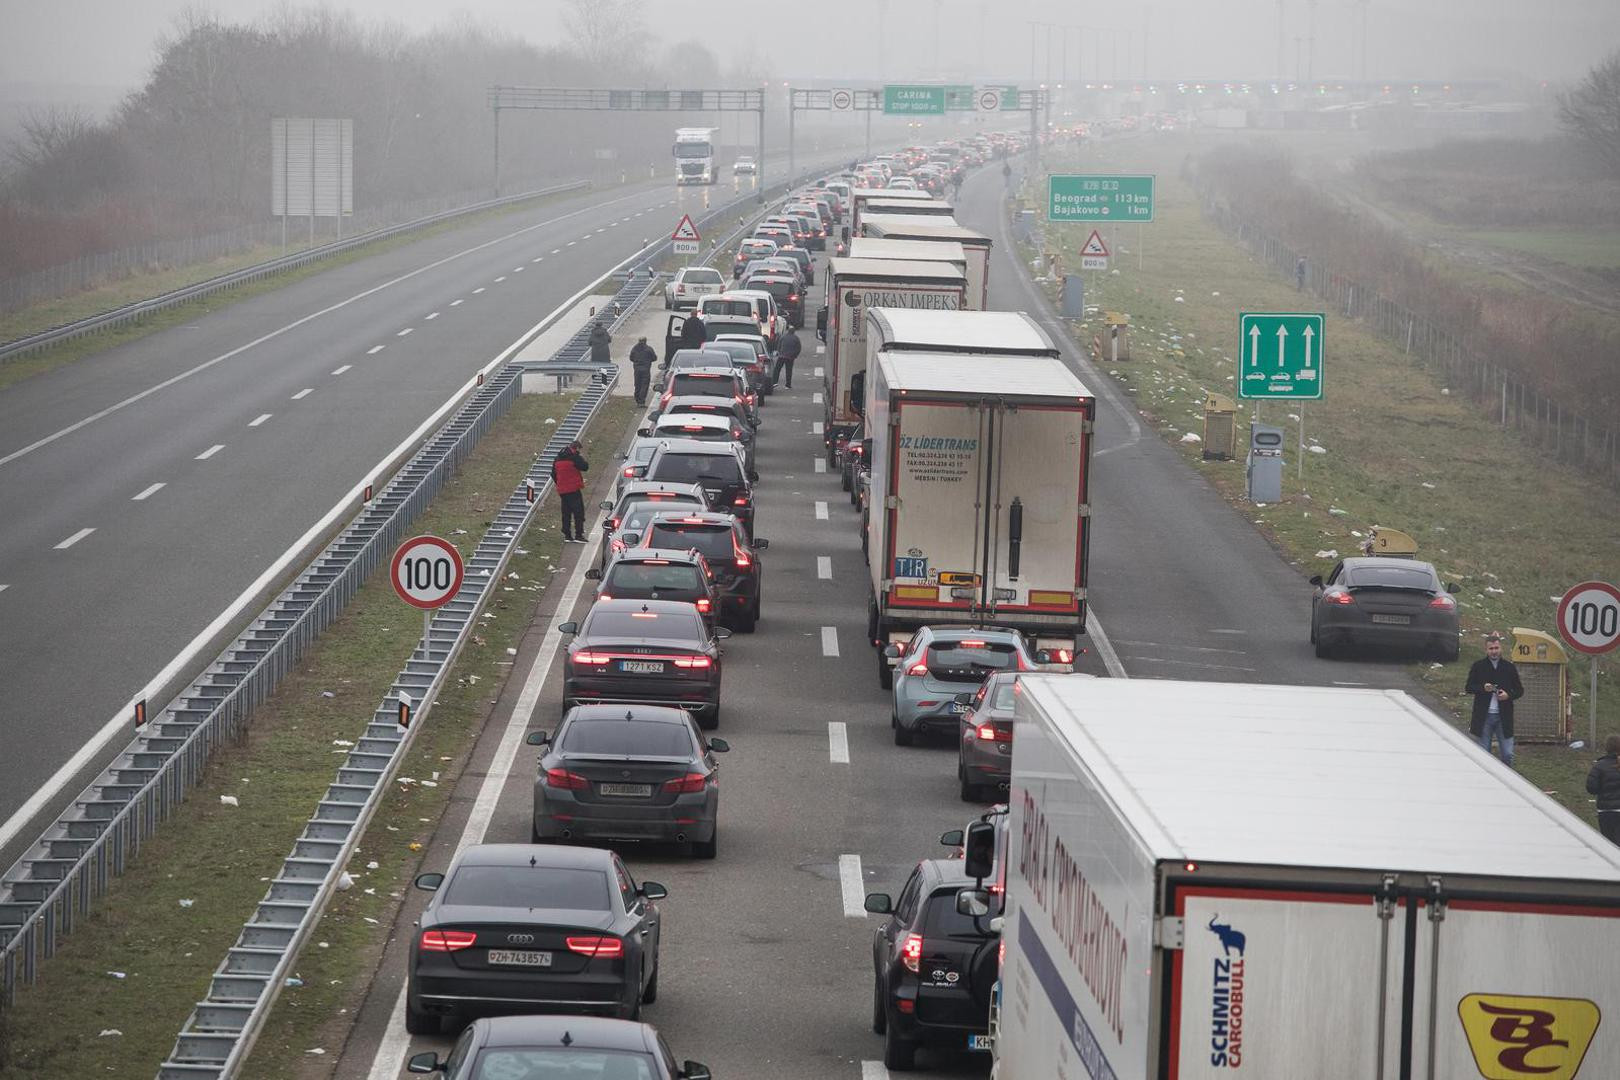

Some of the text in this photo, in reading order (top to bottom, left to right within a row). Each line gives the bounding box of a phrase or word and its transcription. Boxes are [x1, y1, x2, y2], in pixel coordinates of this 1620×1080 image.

[897, 91, 932, 100] CARINA
[1053, 193, 1149, 205] Beograd 113 km
[1053, 205, 1100, 215] Bajakovo
[1134, 205, 1149, 215] km
[676, 243, 690, 251] 800
[863, 291, 958, 311] ORKAN IMPEKS
[899, 433, 978, 451] ÖZ LİDERTRANS
[1381, 538, 1387, 547] 3
[404, 557, 451, 591] 100
[897, 558, 924, 577] TIR
[1571, 602, 1618, 637] 100
[1518, 644, 1530, 656] 10
[626, 661, 664, 672] 1271 KSZ
[1211, 957, 1231, 1068] SCHMITZ
[1228, 958, 1245, 1069] CARGOBULL
